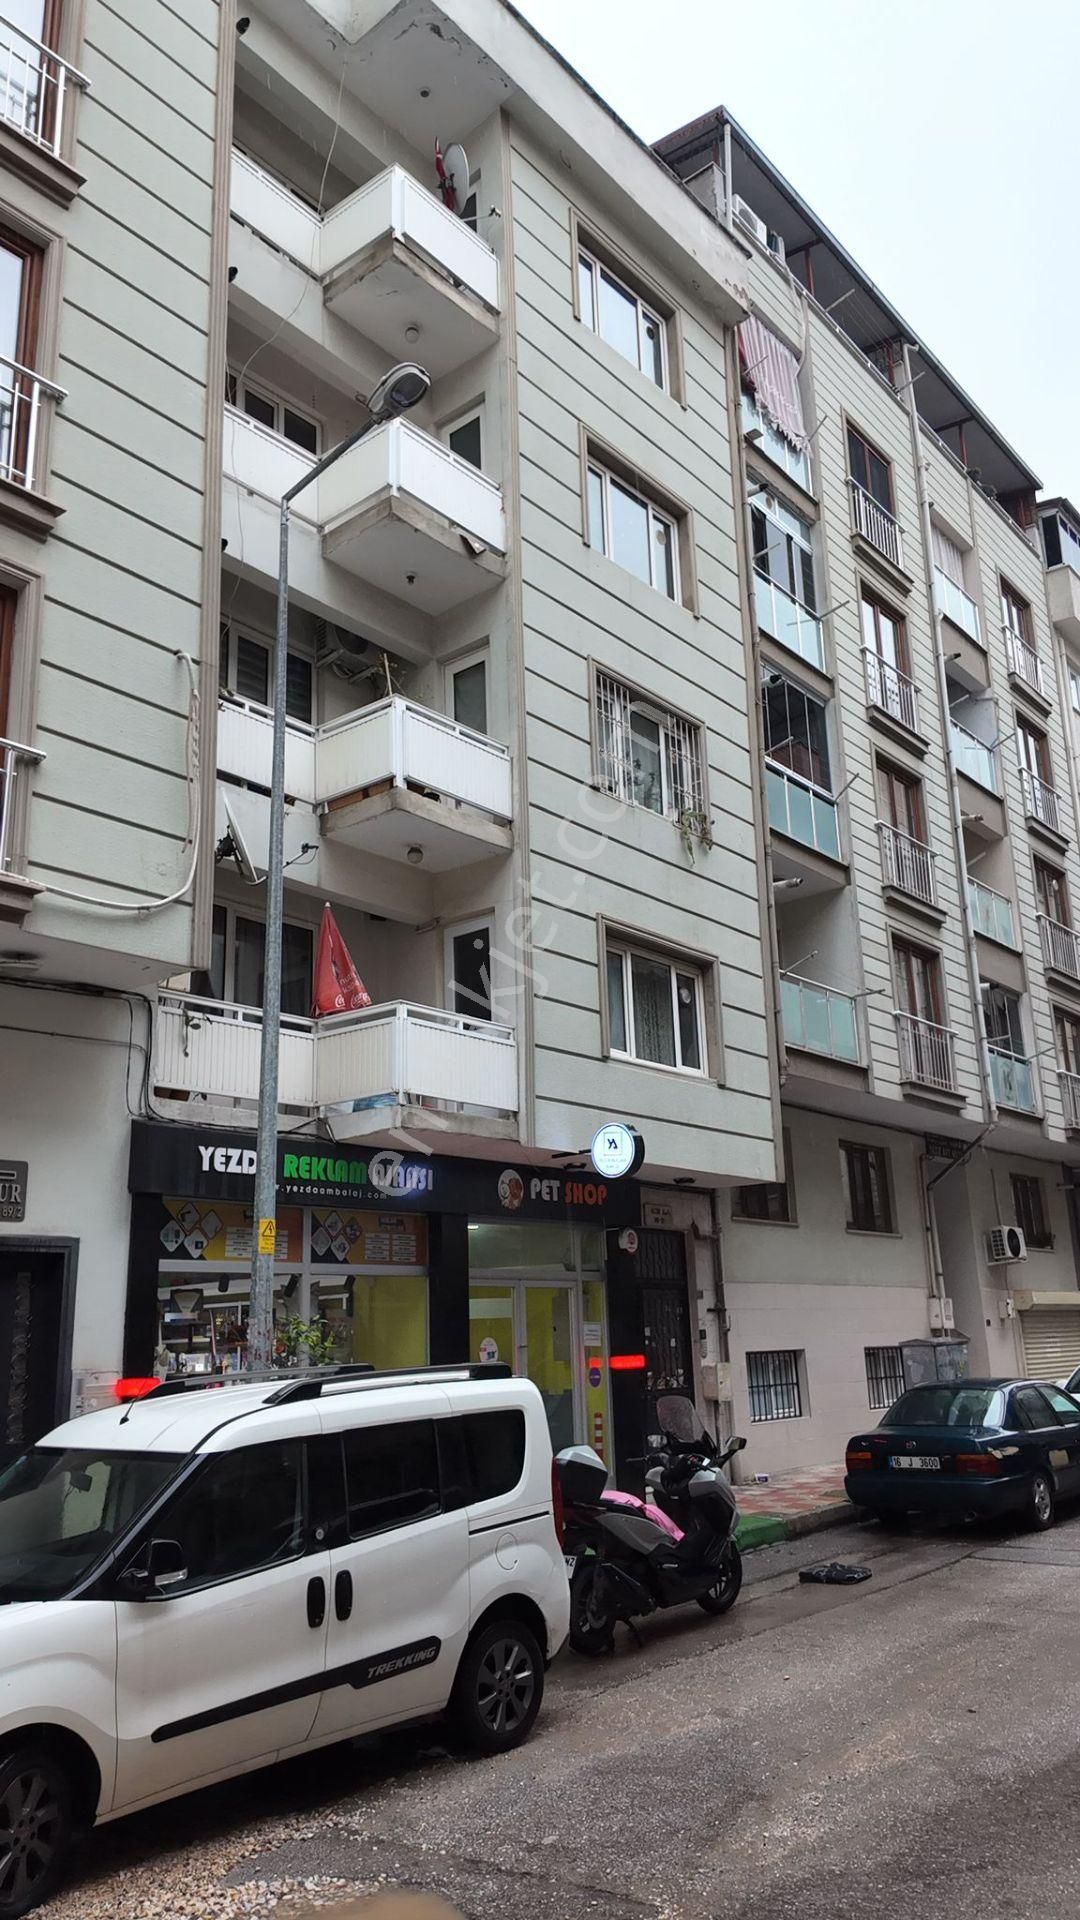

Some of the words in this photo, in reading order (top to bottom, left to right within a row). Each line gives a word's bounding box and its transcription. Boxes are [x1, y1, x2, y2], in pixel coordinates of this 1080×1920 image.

[199, 1146, 257, 1175] YEZD
[284, 1154, 367, 1184] REKLAM
[530, 1178, 560, 1201] PET
[565, 1182, 607, 1205] SHOP
[893, 1457, 902, 1467] 16
[919, 1458, 938, 1468] 3600
[367, 1646, 437, 1679] TREKKING
